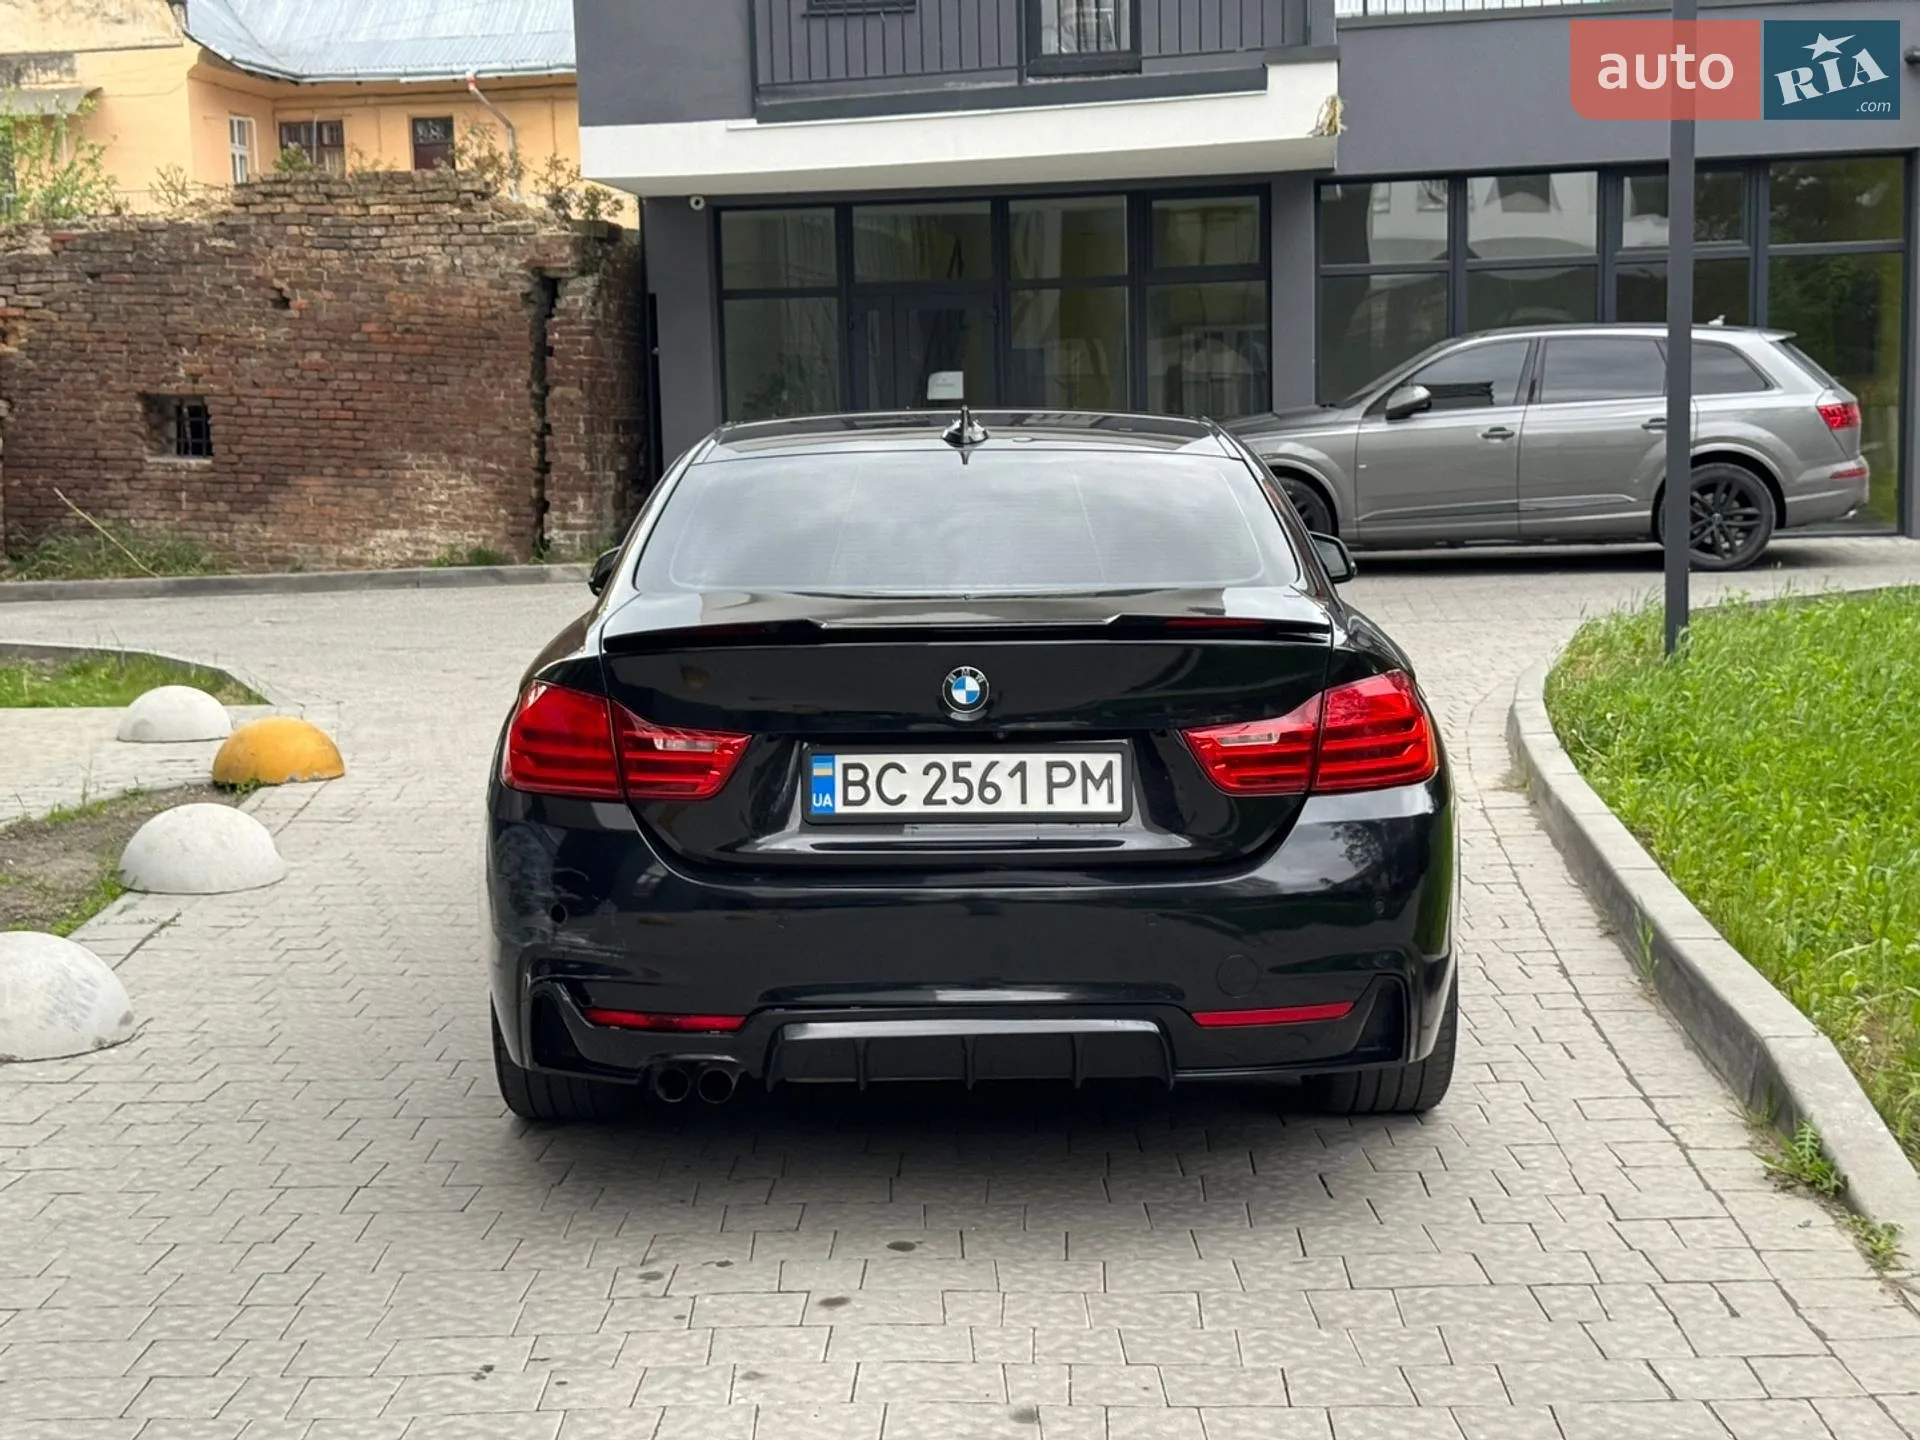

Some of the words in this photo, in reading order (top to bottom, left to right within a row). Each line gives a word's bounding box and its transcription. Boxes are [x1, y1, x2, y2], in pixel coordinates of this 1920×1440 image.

[842, 761, 907, 806] BC
[922, 760, 1027, 806] 2561
[1046, 760, 1114, 805] PM
[812, 793, 833, 807] UA
